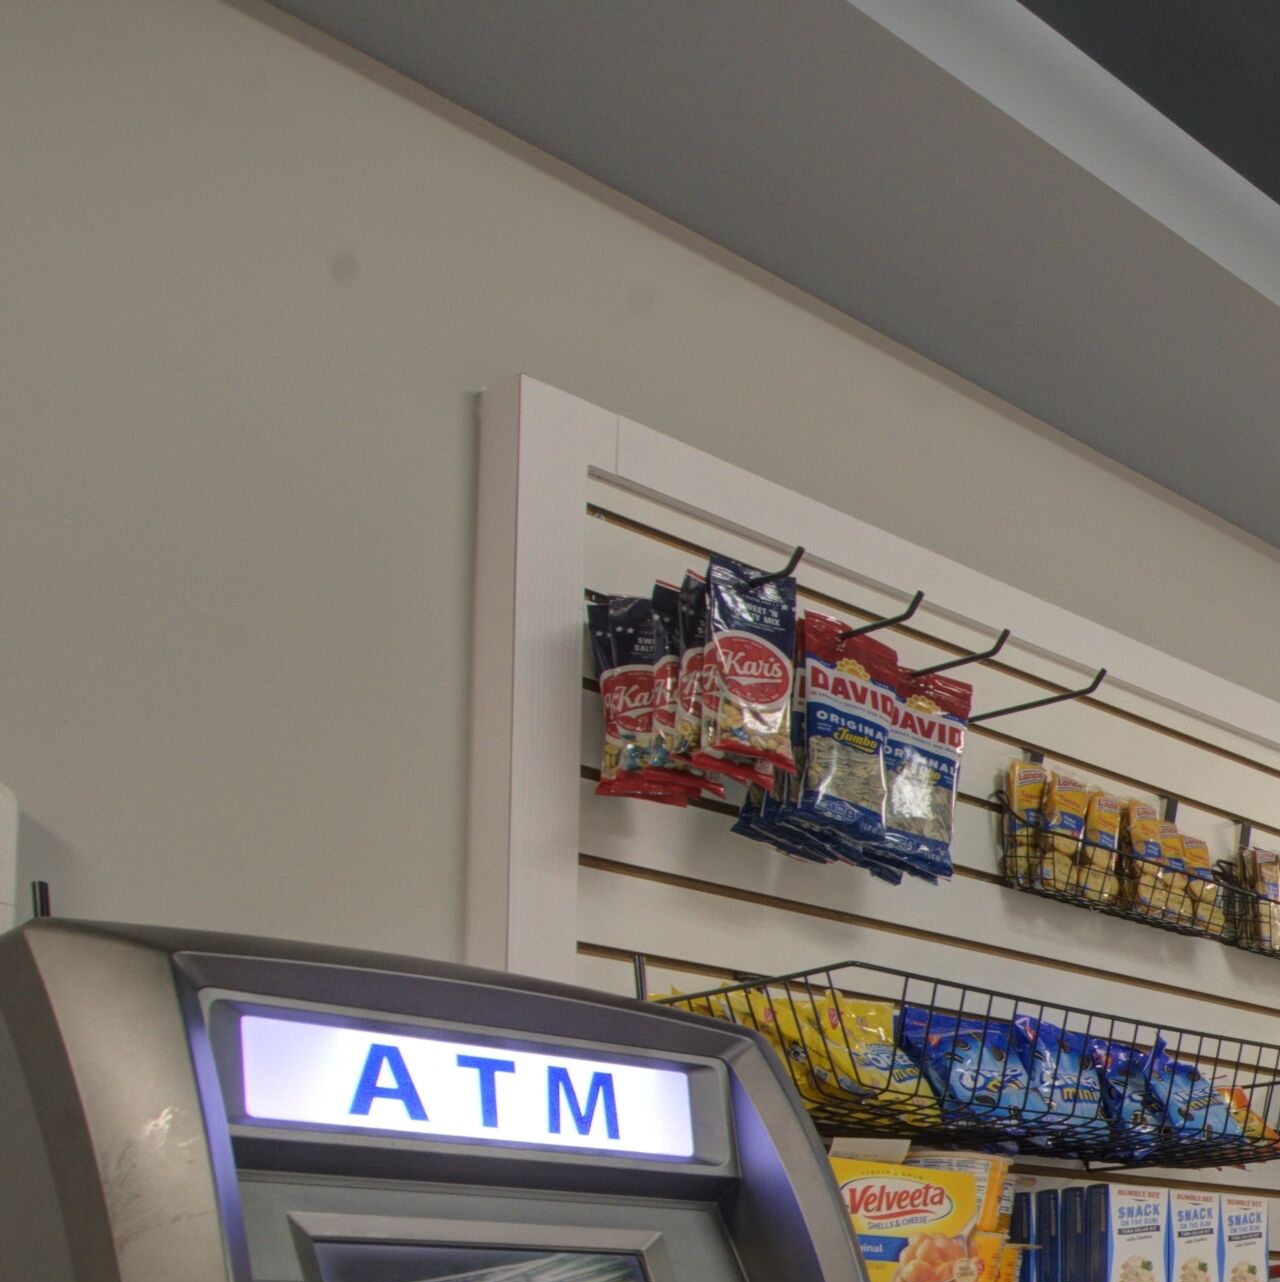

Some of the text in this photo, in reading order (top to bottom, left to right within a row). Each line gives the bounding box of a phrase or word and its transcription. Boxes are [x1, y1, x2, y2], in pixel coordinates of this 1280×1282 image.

[716, 649, 784, 679] Kar's
[810, 665, 893, 719] DAVID
[833, 727, 878, 753] Jumbo
[348, 1043, 621, 1140] ATM
[848, 1183, 945, 1215] Velveeta
[1118, 1204, 1161, 1219] SNACK
[1177, 1207, 1213, 1222] SNACK
[1228, 1212, 1262, 1227] SNACK
[867, 1220, 895, 1231] SHELLS
[902, 1215, 929, 1225] CHEESE
[860, 1243, 883, 1254] inal
